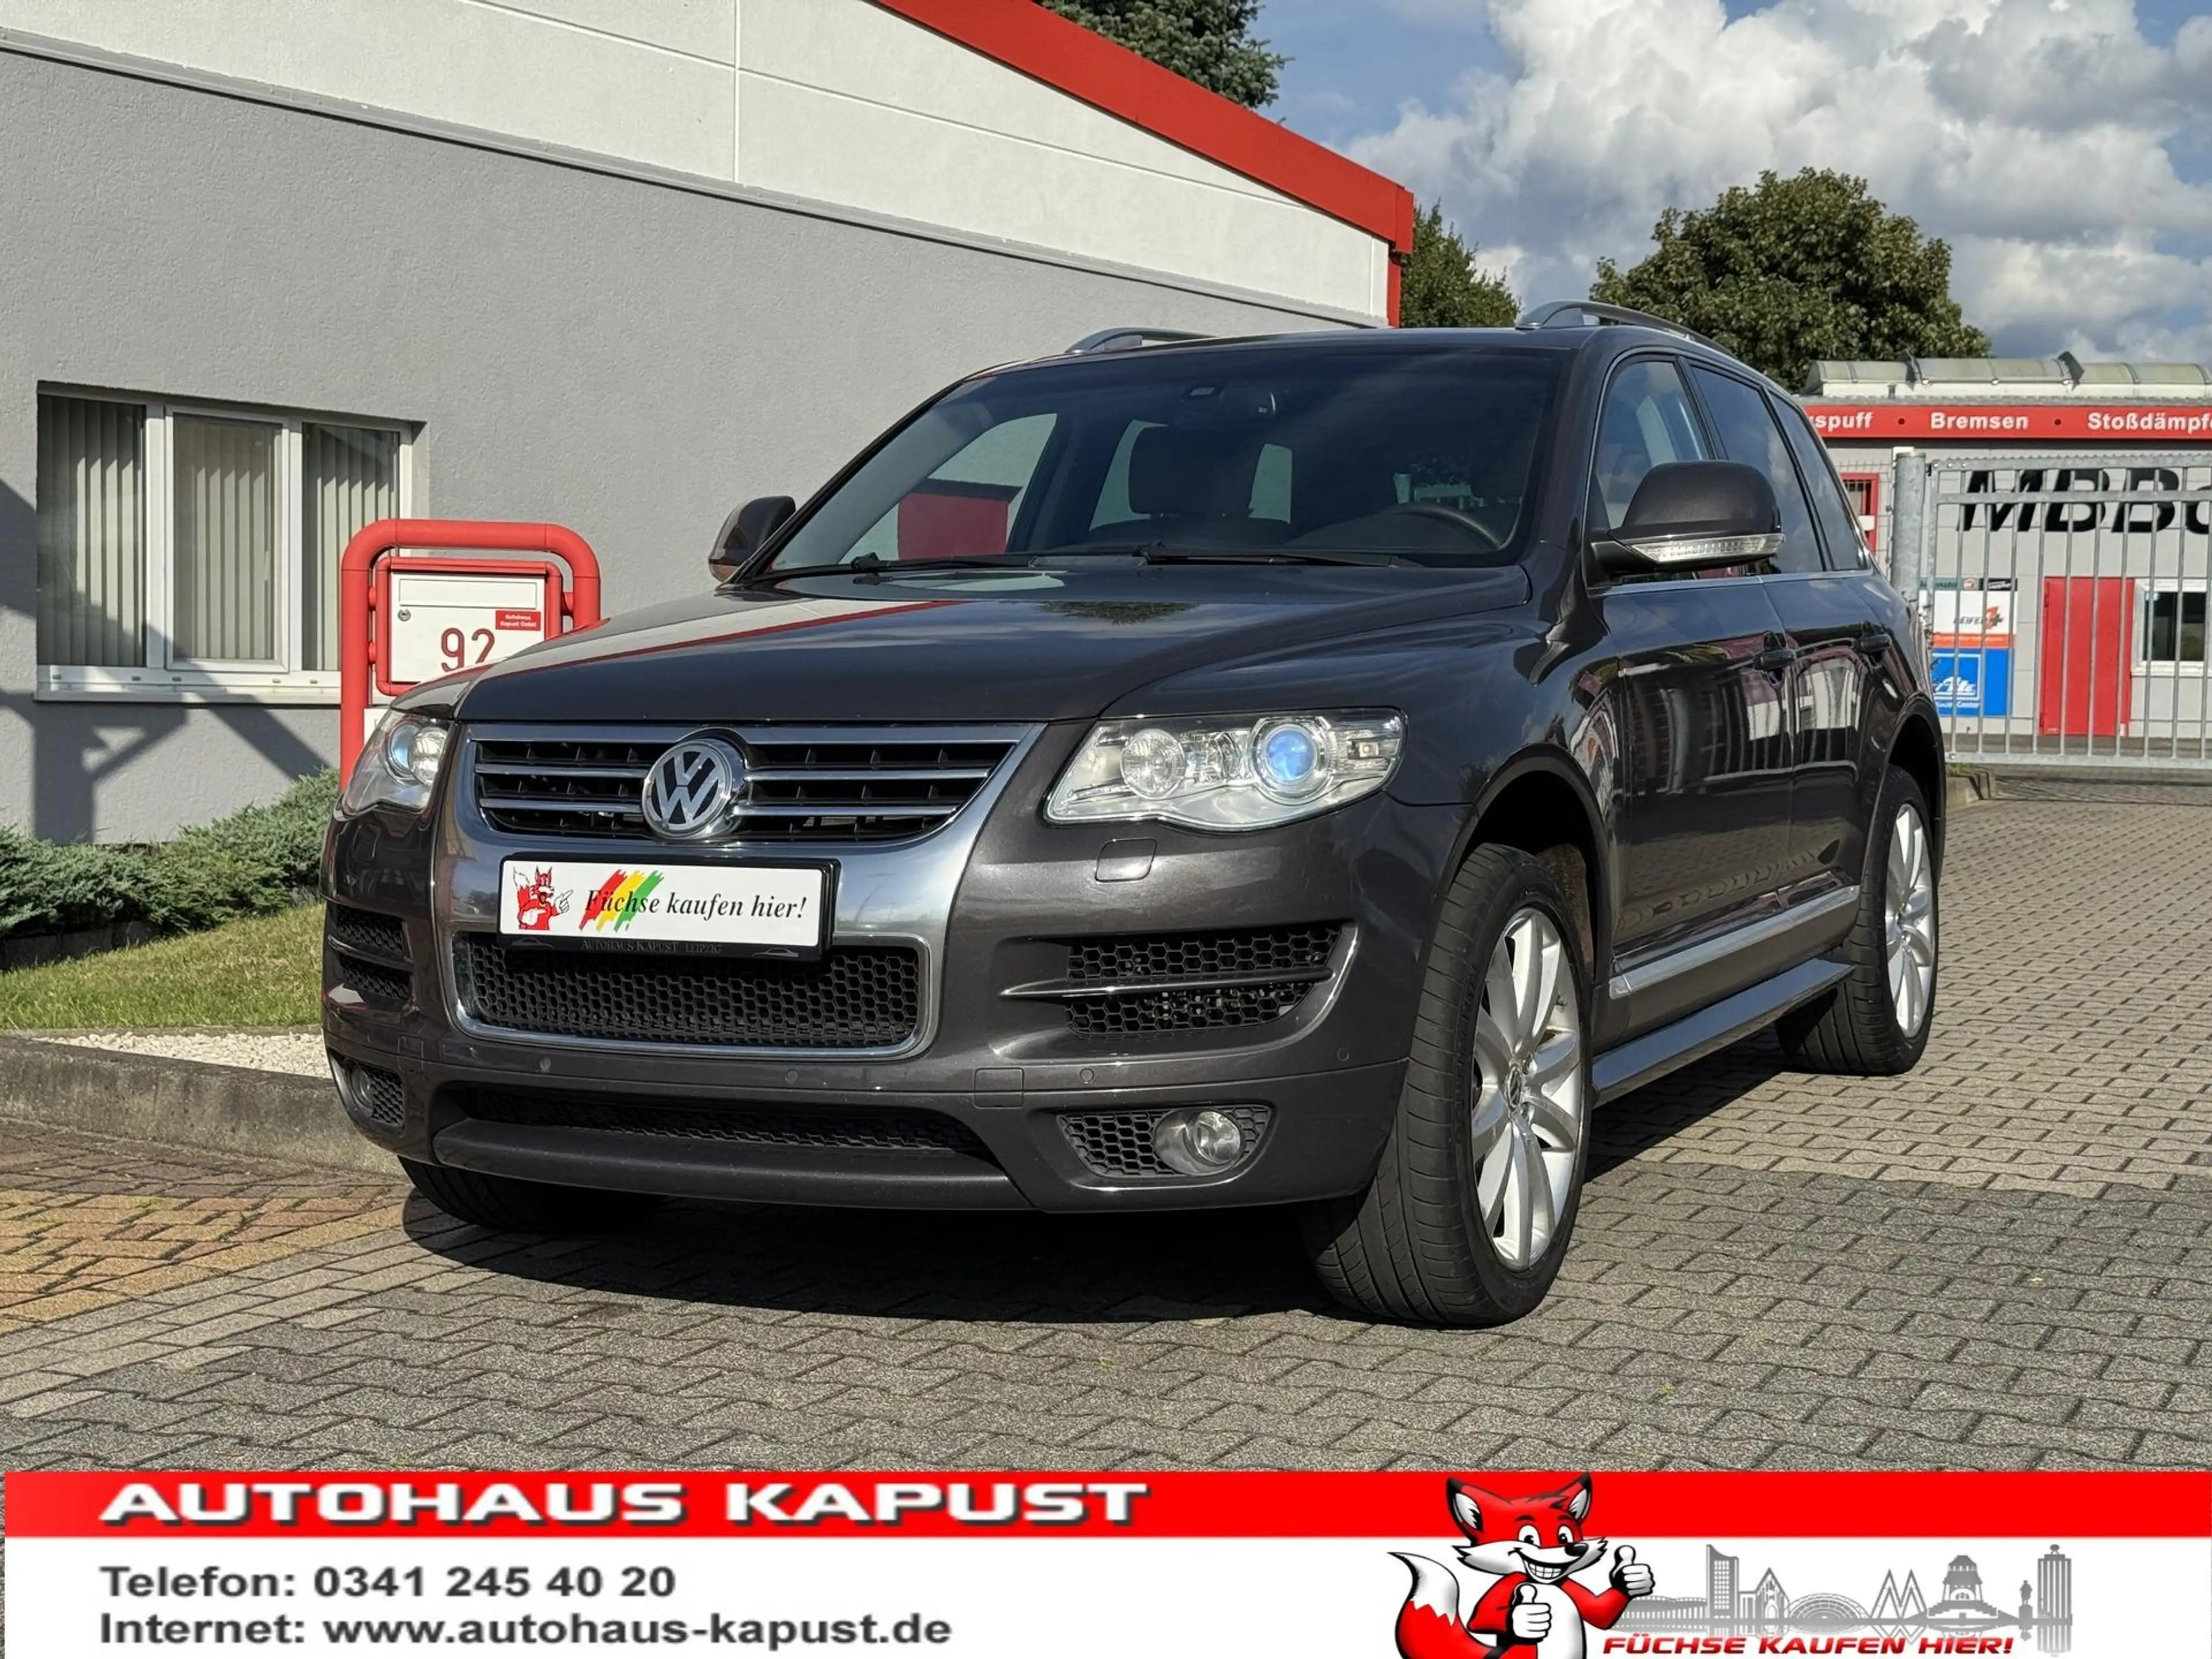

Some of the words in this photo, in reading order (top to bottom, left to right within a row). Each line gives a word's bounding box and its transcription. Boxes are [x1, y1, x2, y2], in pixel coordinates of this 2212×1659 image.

[1930, 412, 2029, 430] Bremsen
[2088, 412, 2212, 434] Stoßdämpf
[441, 628, 495, 673] 92
[586, 889, 660, 915] Füchse
[666, 891, 743, 922] kaufen
[751, 895, 808, 919] hier!
